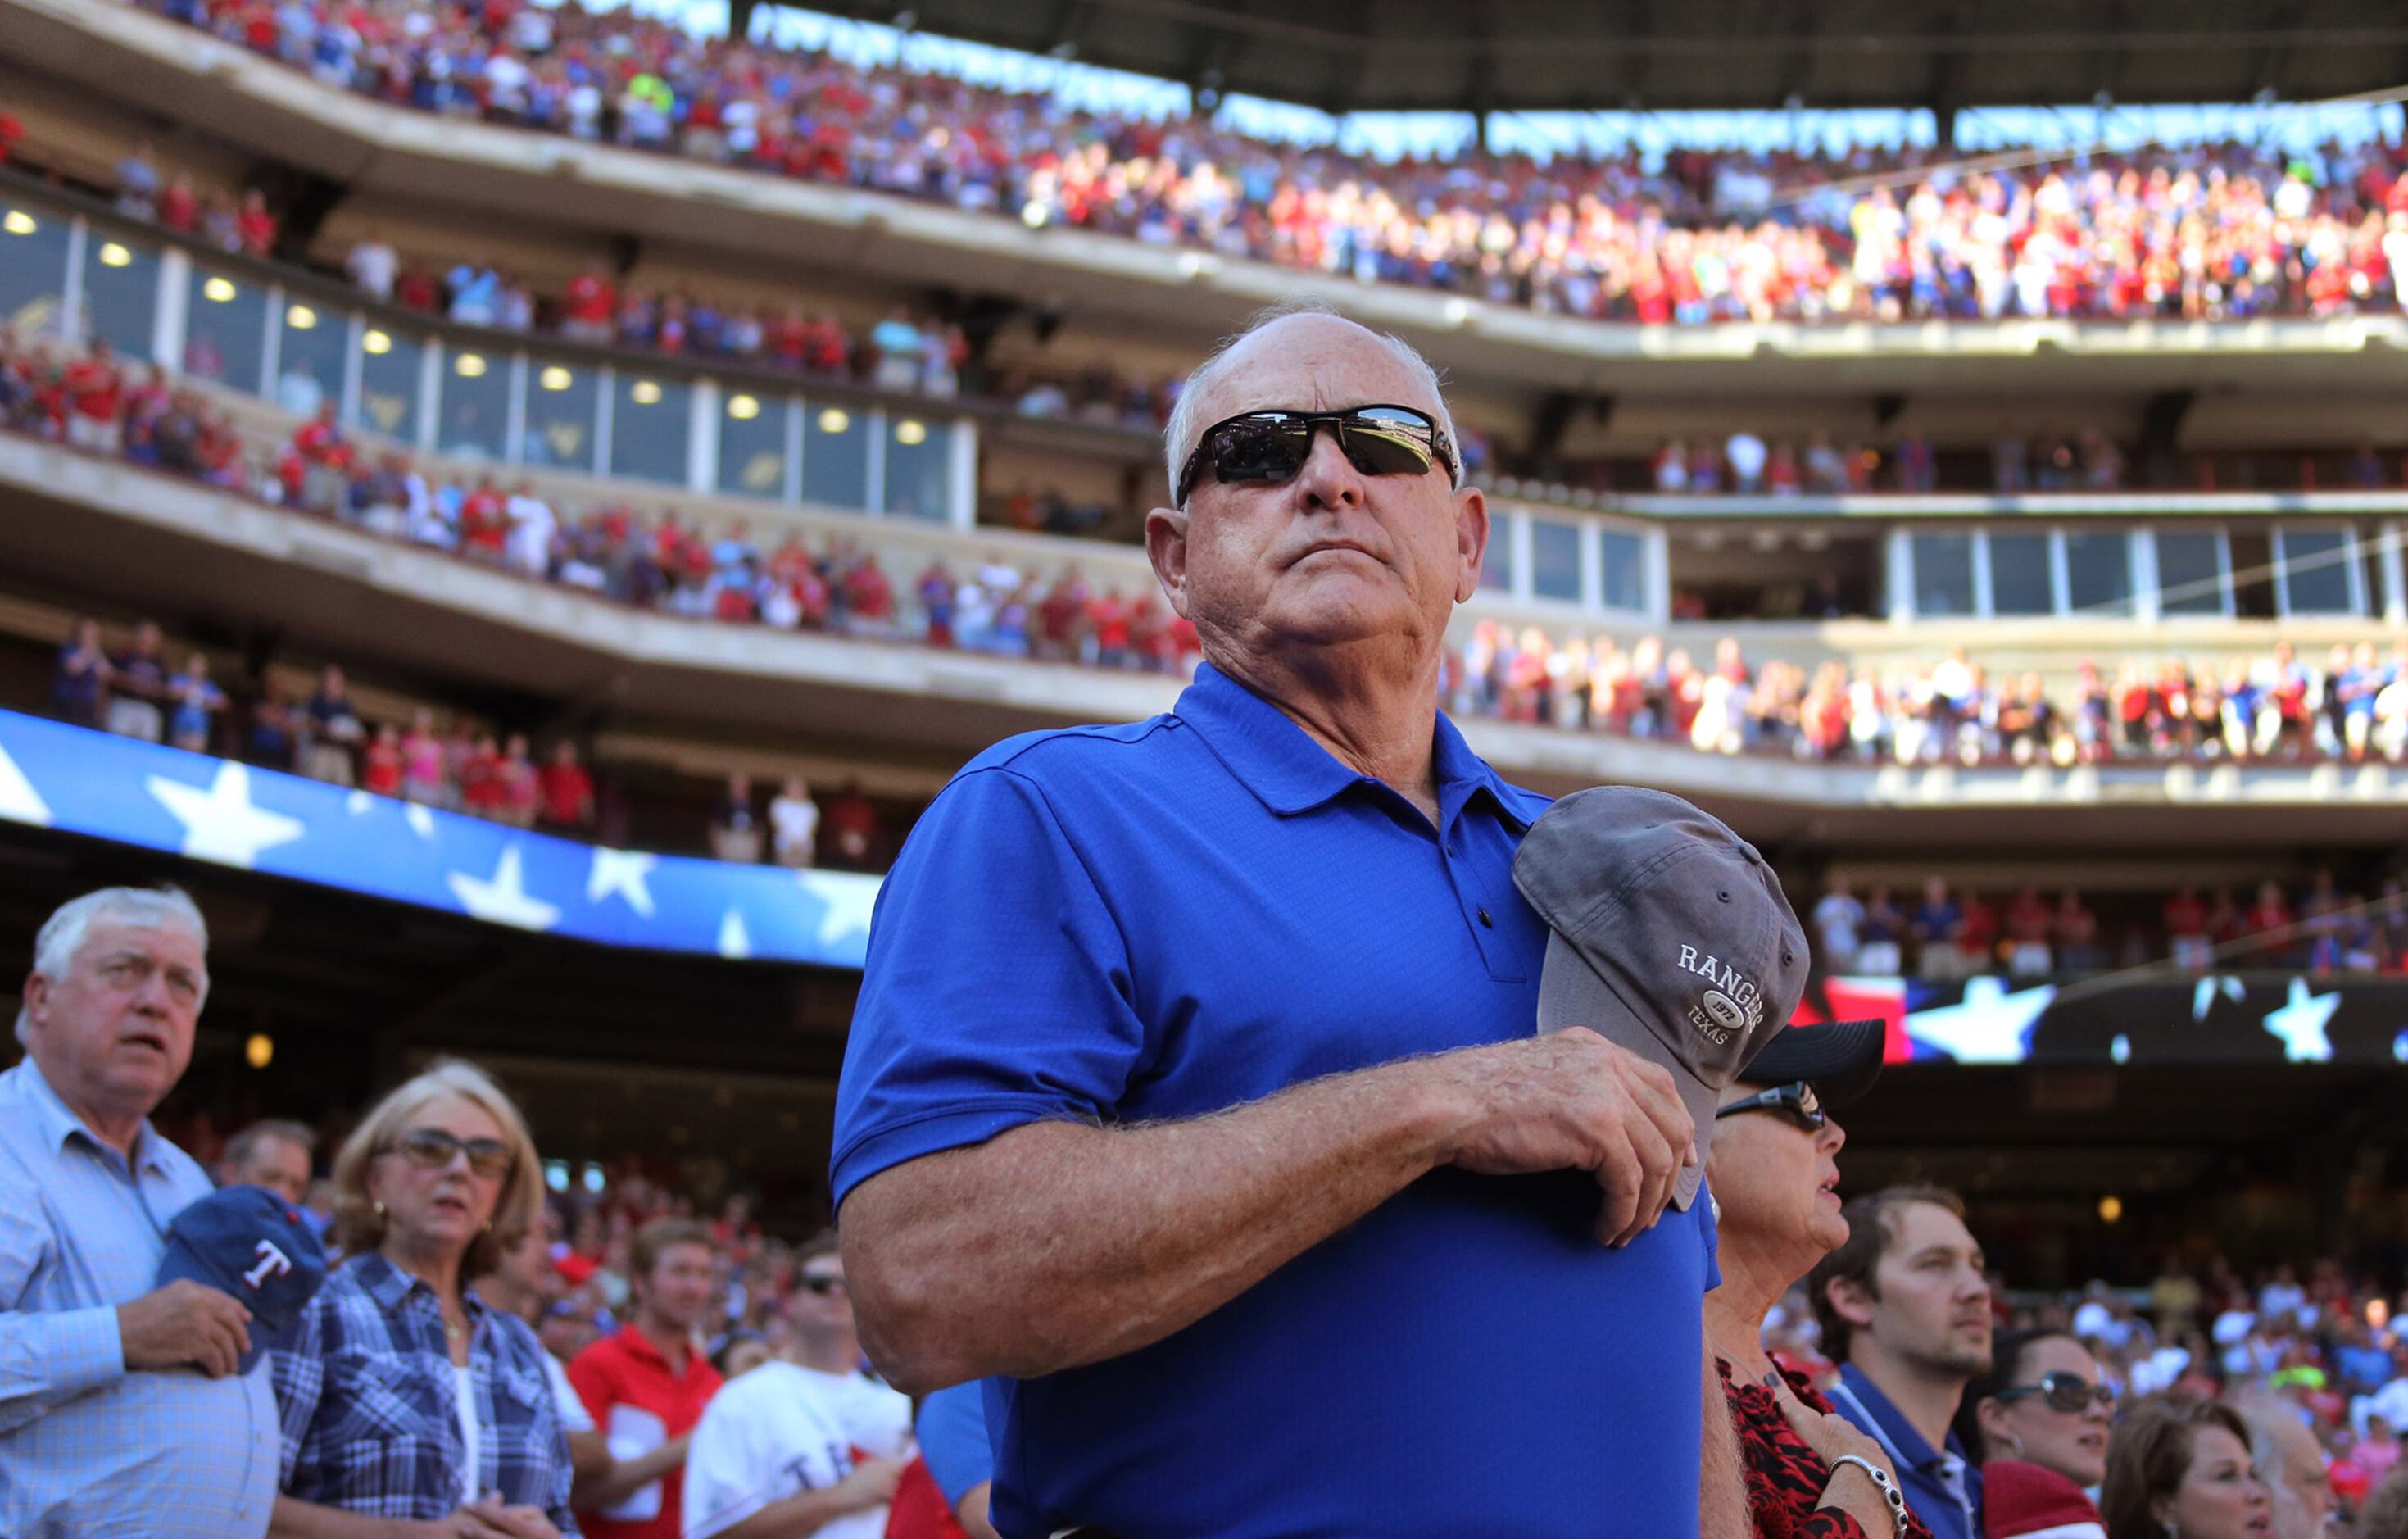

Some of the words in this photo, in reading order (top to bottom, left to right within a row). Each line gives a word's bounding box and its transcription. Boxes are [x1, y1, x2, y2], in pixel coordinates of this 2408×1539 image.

[1677, 943, 1764, 1033] RANGERS
[1712, 1001, 1735, 1021] 1972
[1688, 1005, 1729, 1045] TEXAS
[243, 1238, 292, 1290] T
